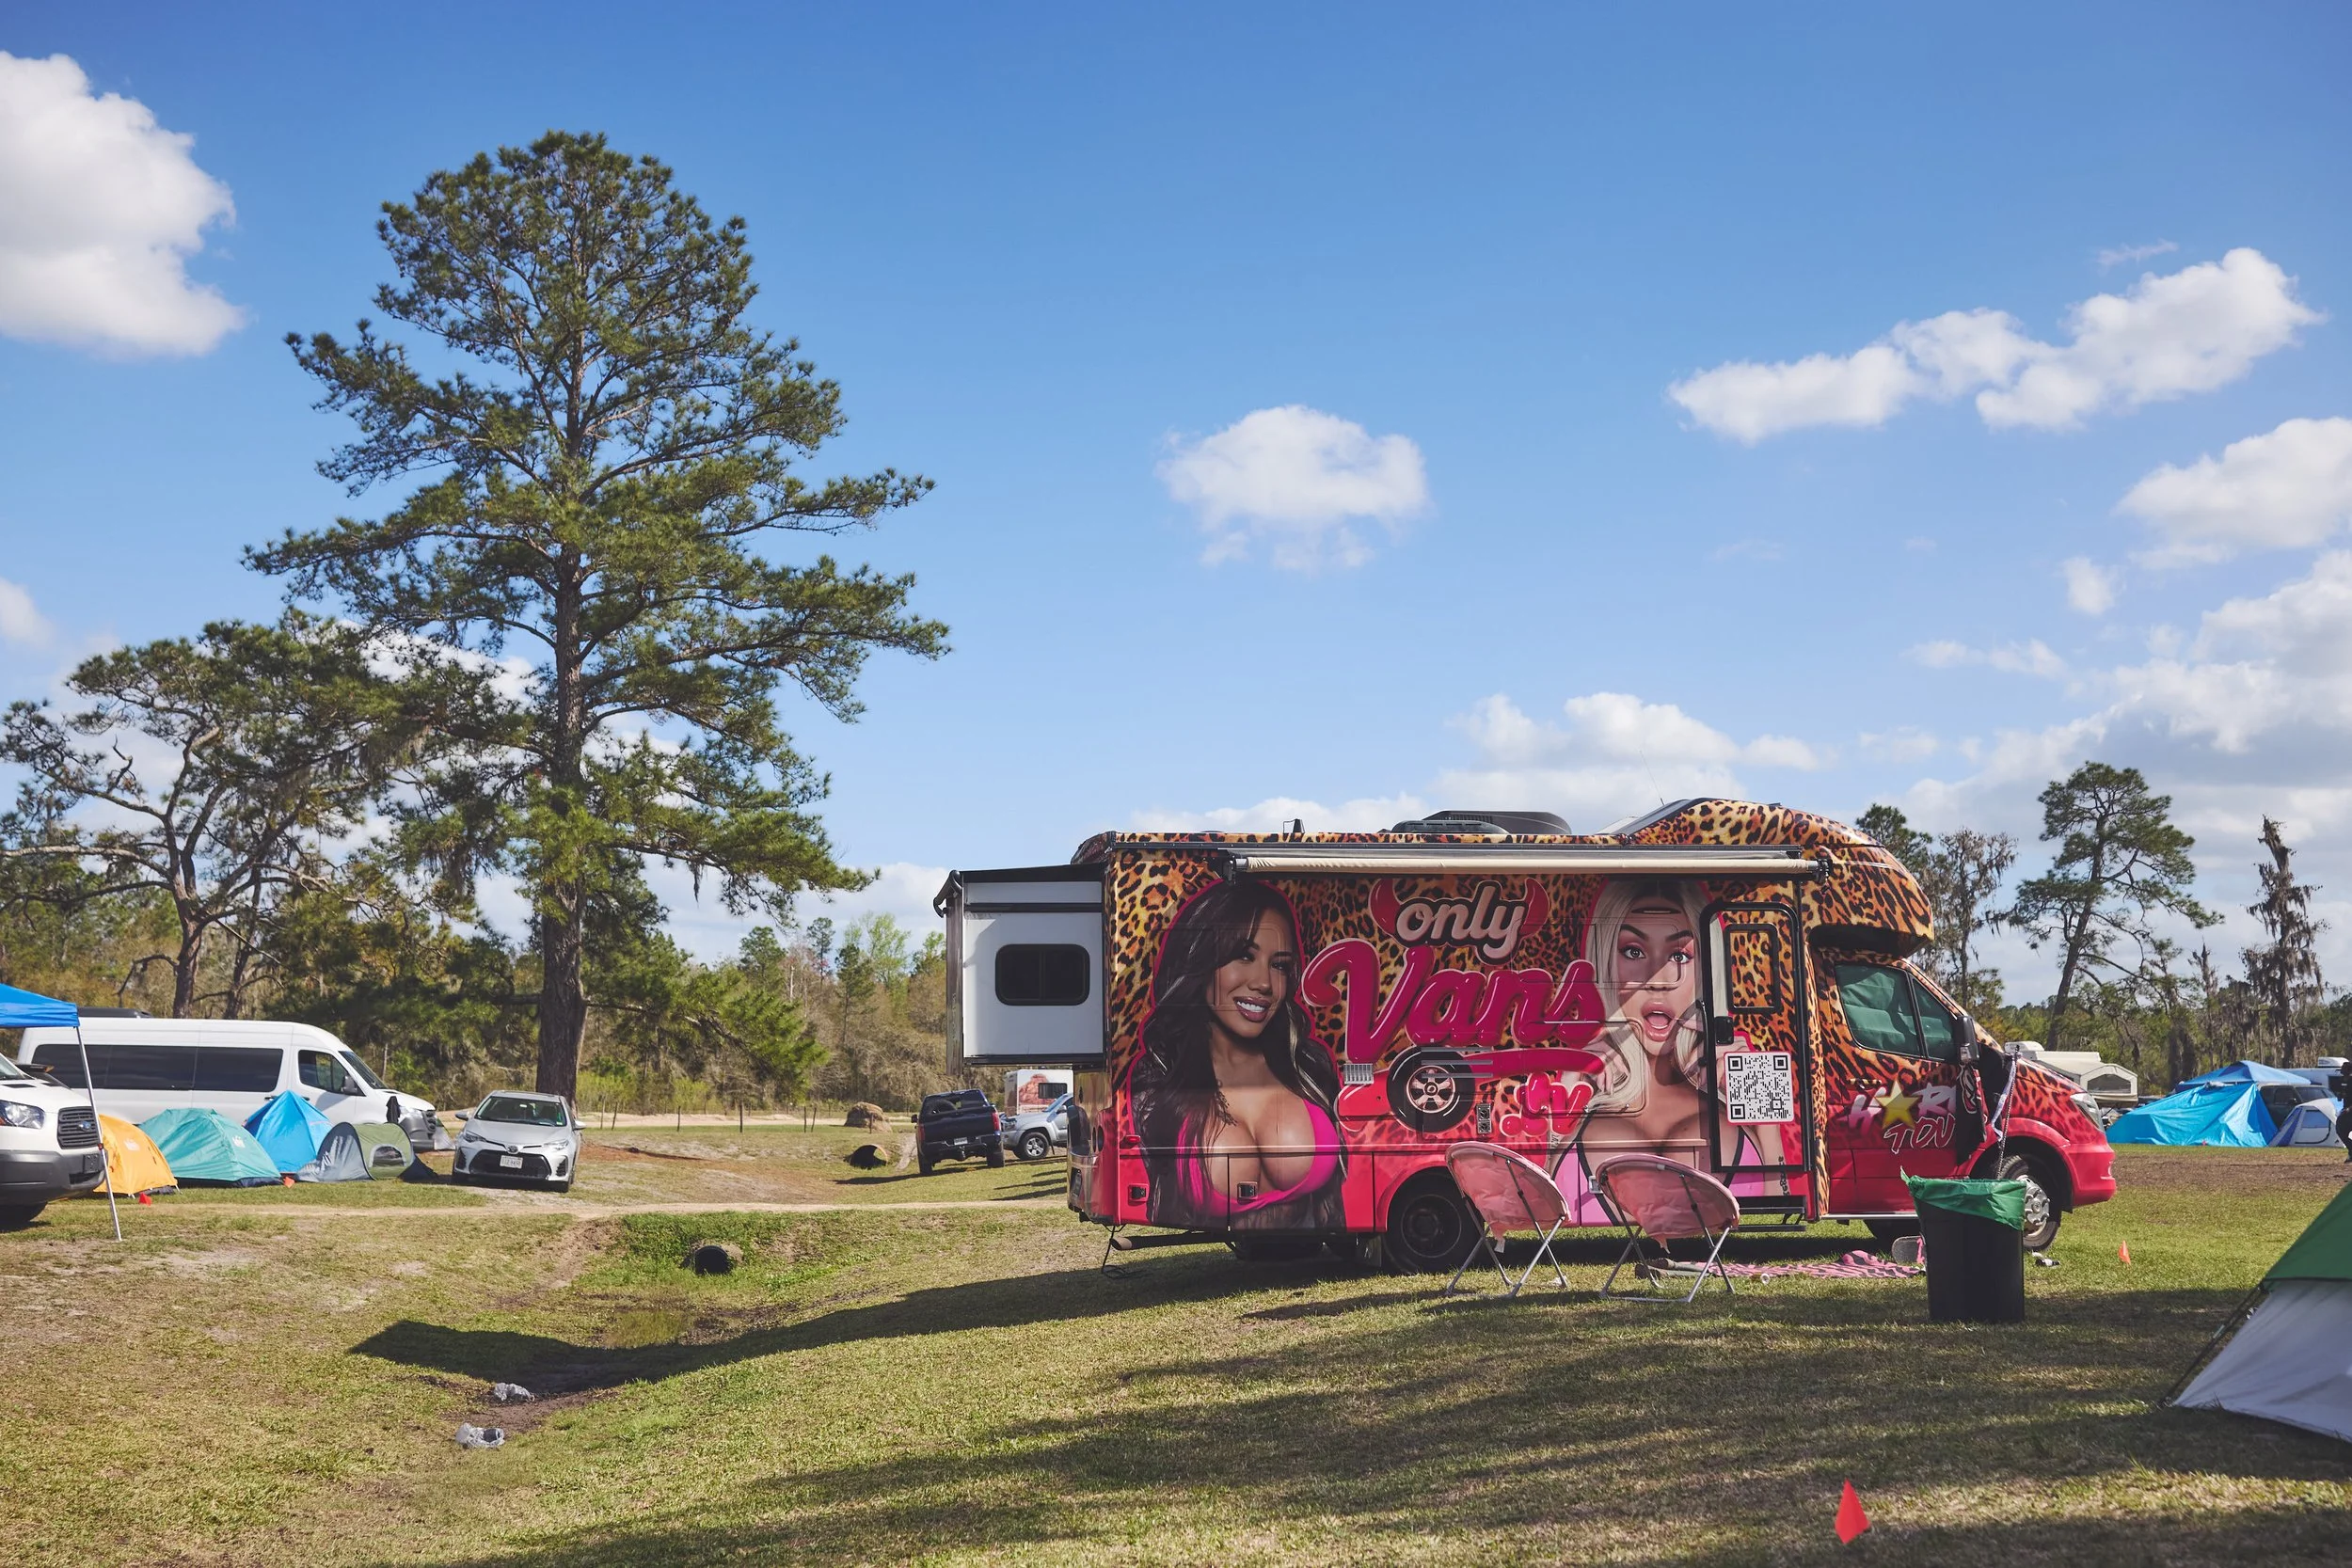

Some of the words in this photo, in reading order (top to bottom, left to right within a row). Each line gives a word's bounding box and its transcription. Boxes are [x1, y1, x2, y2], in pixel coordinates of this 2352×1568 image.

[1393, 883, 1527, 960] only
[1301, 938, 1605, 1063] Vans
[1883, 1114, 1956, 1154] TOU
